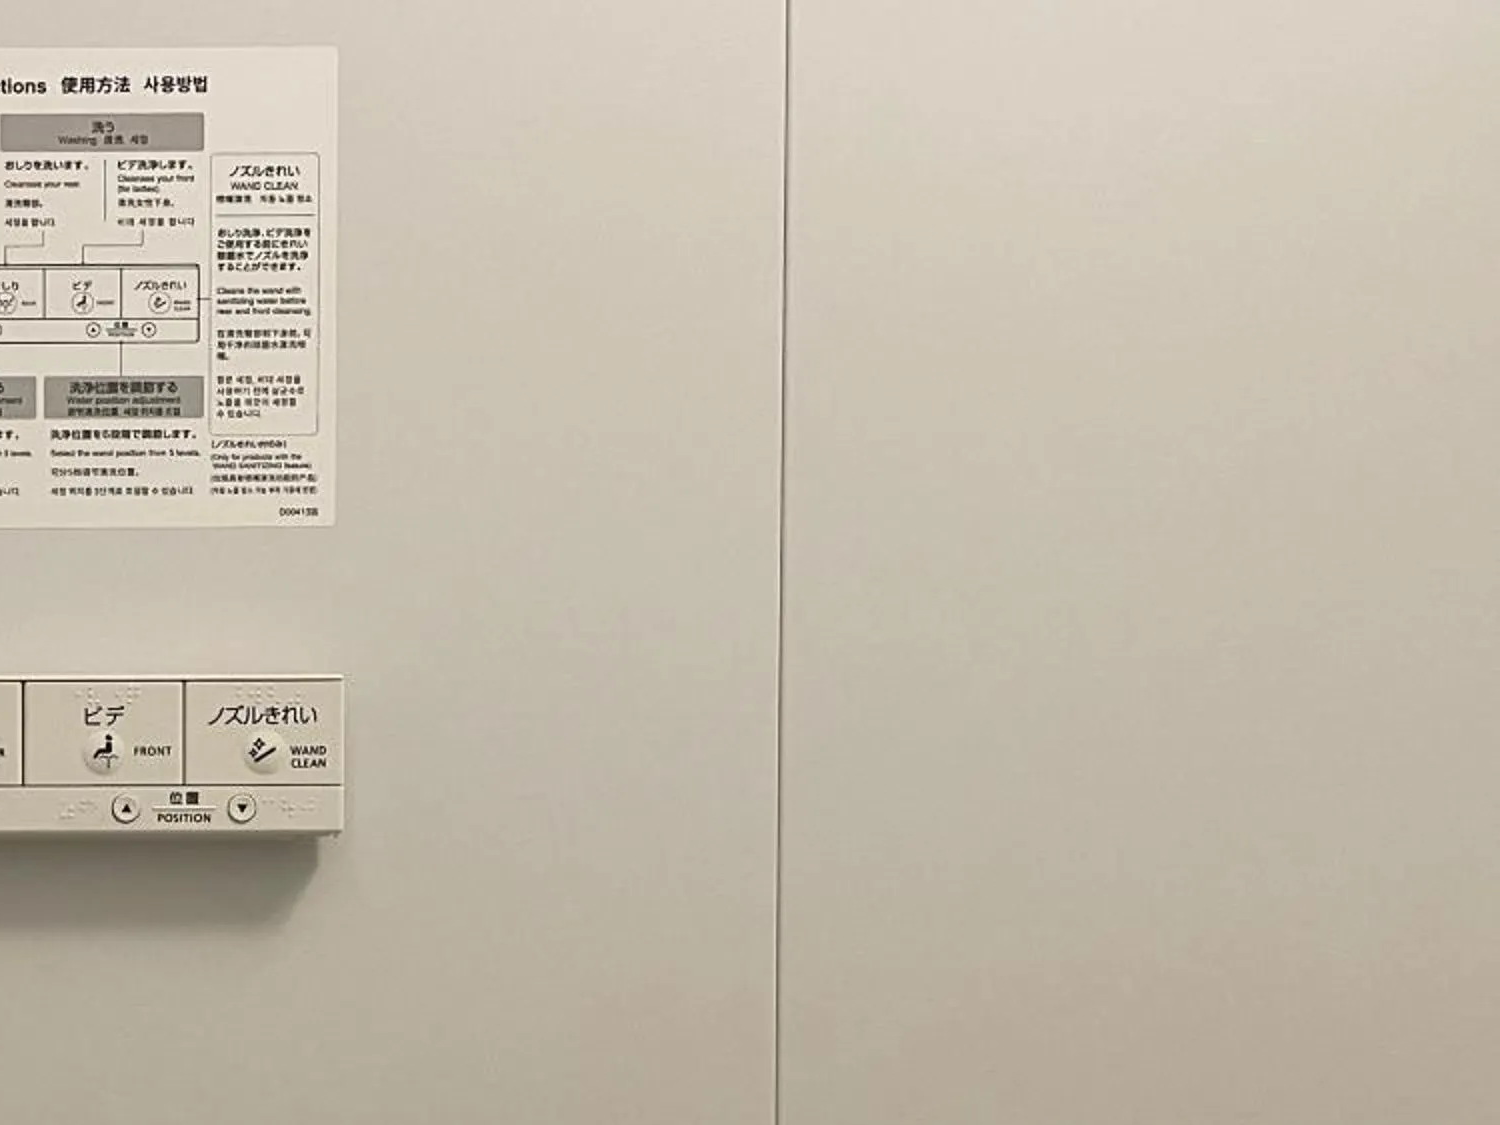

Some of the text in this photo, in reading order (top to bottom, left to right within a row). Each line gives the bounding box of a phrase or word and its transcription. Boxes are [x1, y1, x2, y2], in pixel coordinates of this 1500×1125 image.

[61, 76, 130, 94] 使用方法
[144, 76, 207, 93] 사용방법
[92, 121, 114, 136] 洗う
[58, 136, 97, 146] Washing
[229, 166, 300, 177] ノズルきれい
[231, 181, 298, 190] WAND CLEAN
[84, 706, 124, 726] ビデ
[208, 706, 317, 725] ノズルきれい
[134, 746, 171, 756] FRONT
[290, 746, 327, 755] WAND
[291, 758, 326, 768] CLEAN
[158, 813, 211, 823] POSITION
